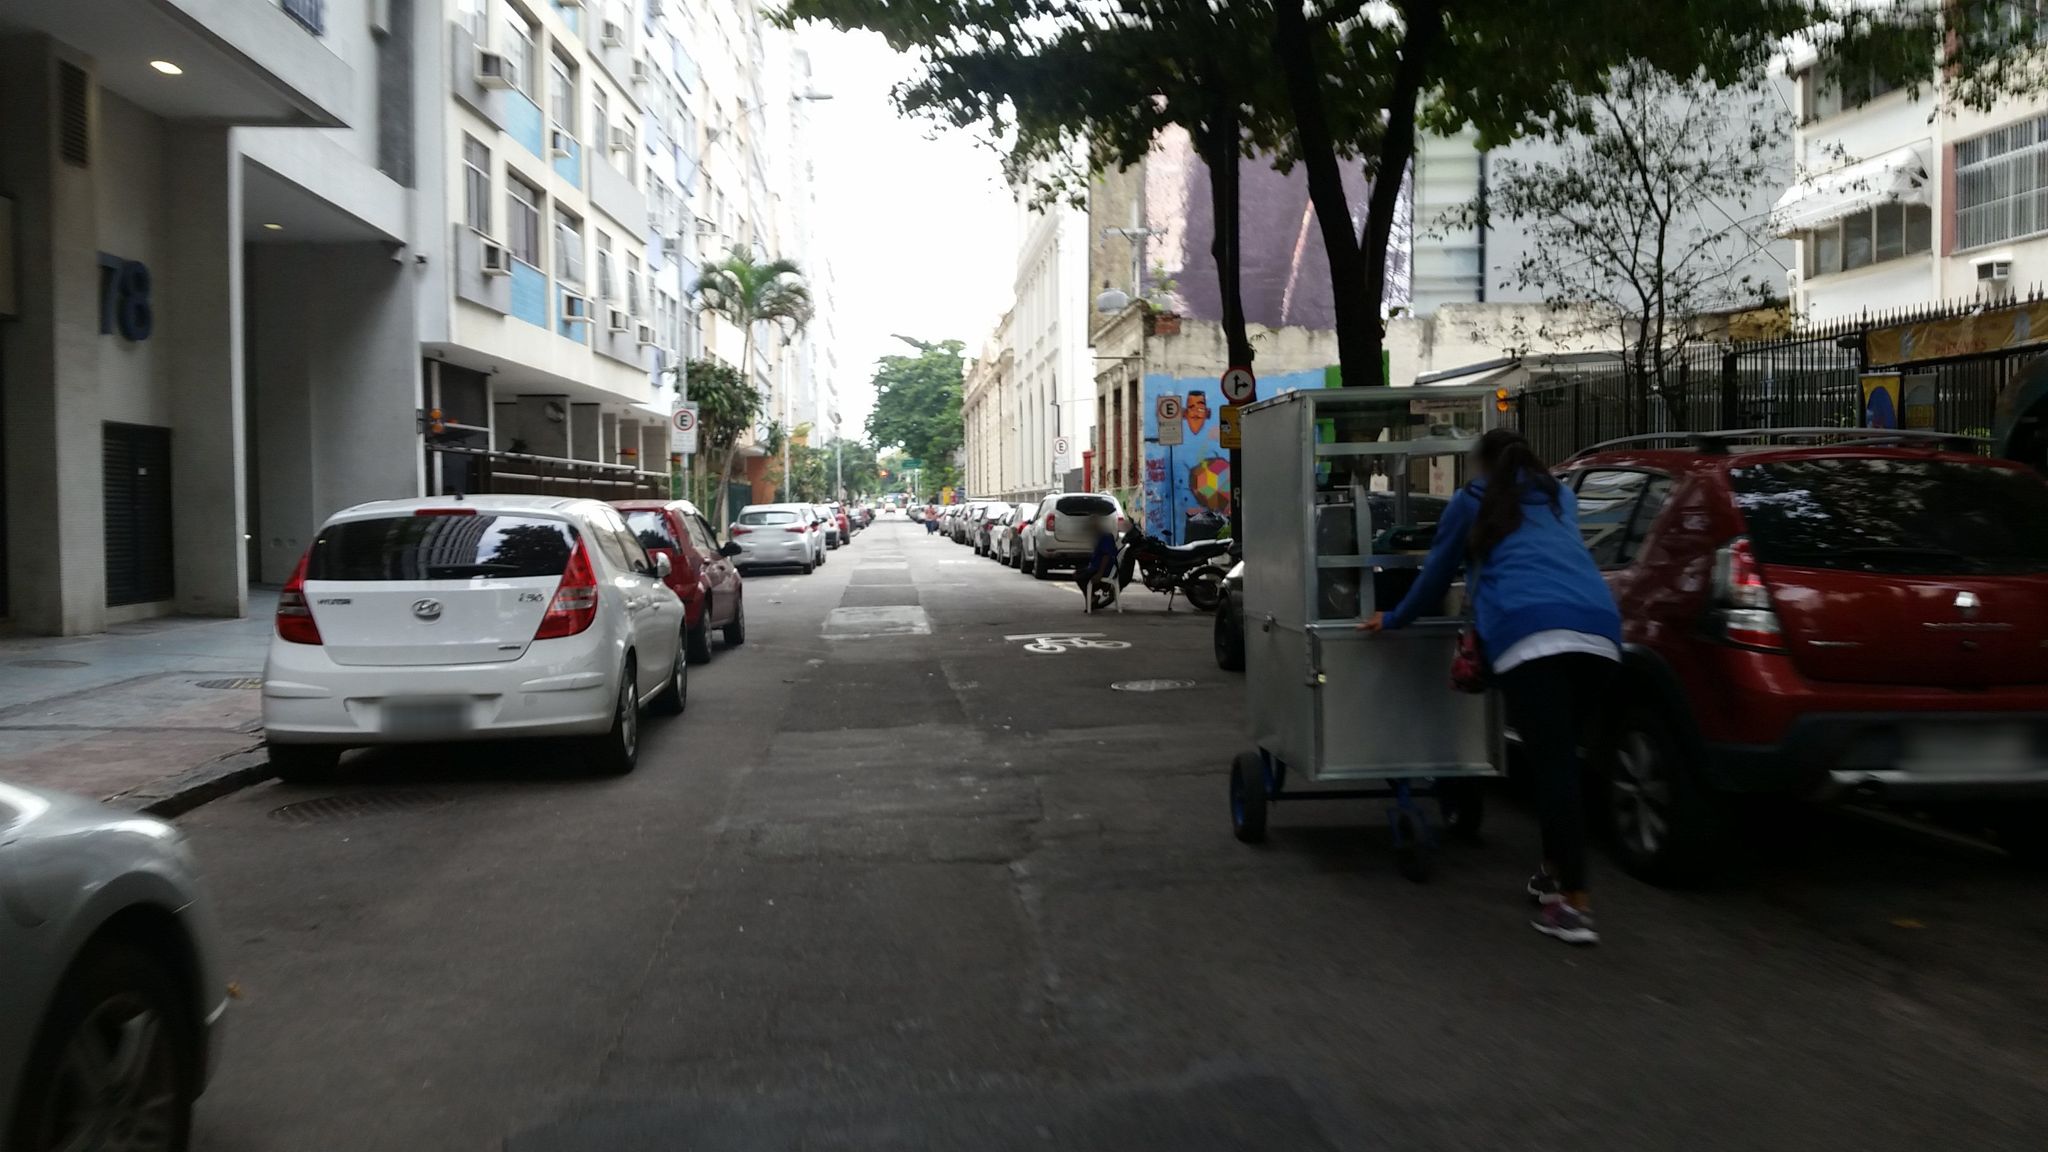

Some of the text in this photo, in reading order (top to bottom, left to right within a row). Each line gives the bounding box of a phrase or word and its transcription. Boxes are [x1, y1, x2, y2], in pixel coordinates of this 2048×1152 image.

[97, 250, 152, 341] 78
[1166, 403, 1174, 415] E
[680, 414, 688, 427] E
